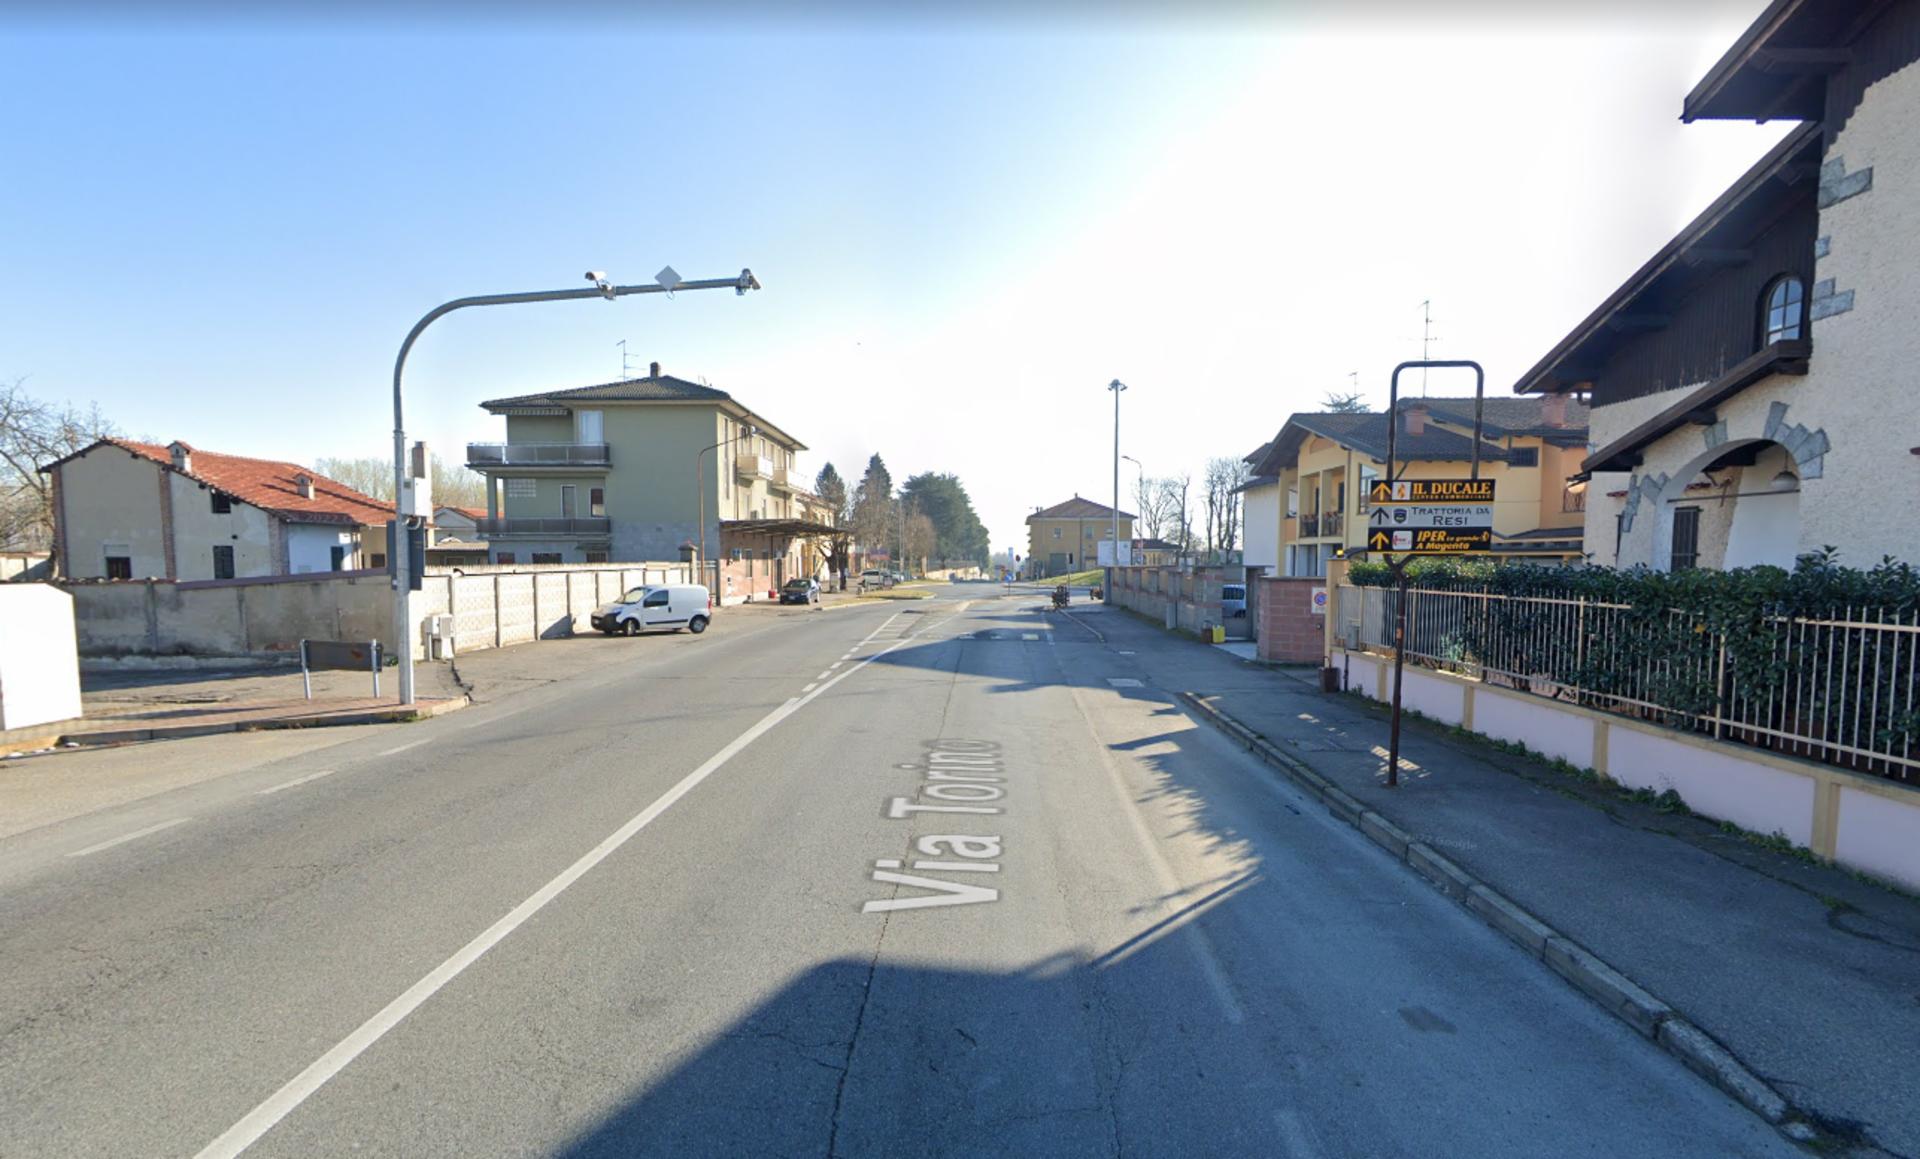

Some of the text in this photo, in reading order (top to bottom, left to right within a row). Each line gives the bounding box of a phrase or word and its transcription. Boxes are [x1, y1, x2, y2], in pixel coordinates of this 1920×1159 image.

[1413, 482, 1491, 494] IL DUCALE
[1412, 507, 1472, 515] TRATTORIA
[1433, 516, 1468, 526] RESI
[1417, 531, 1447, 542] IPER
[1416, 542, 1470, 550] A Magenta
